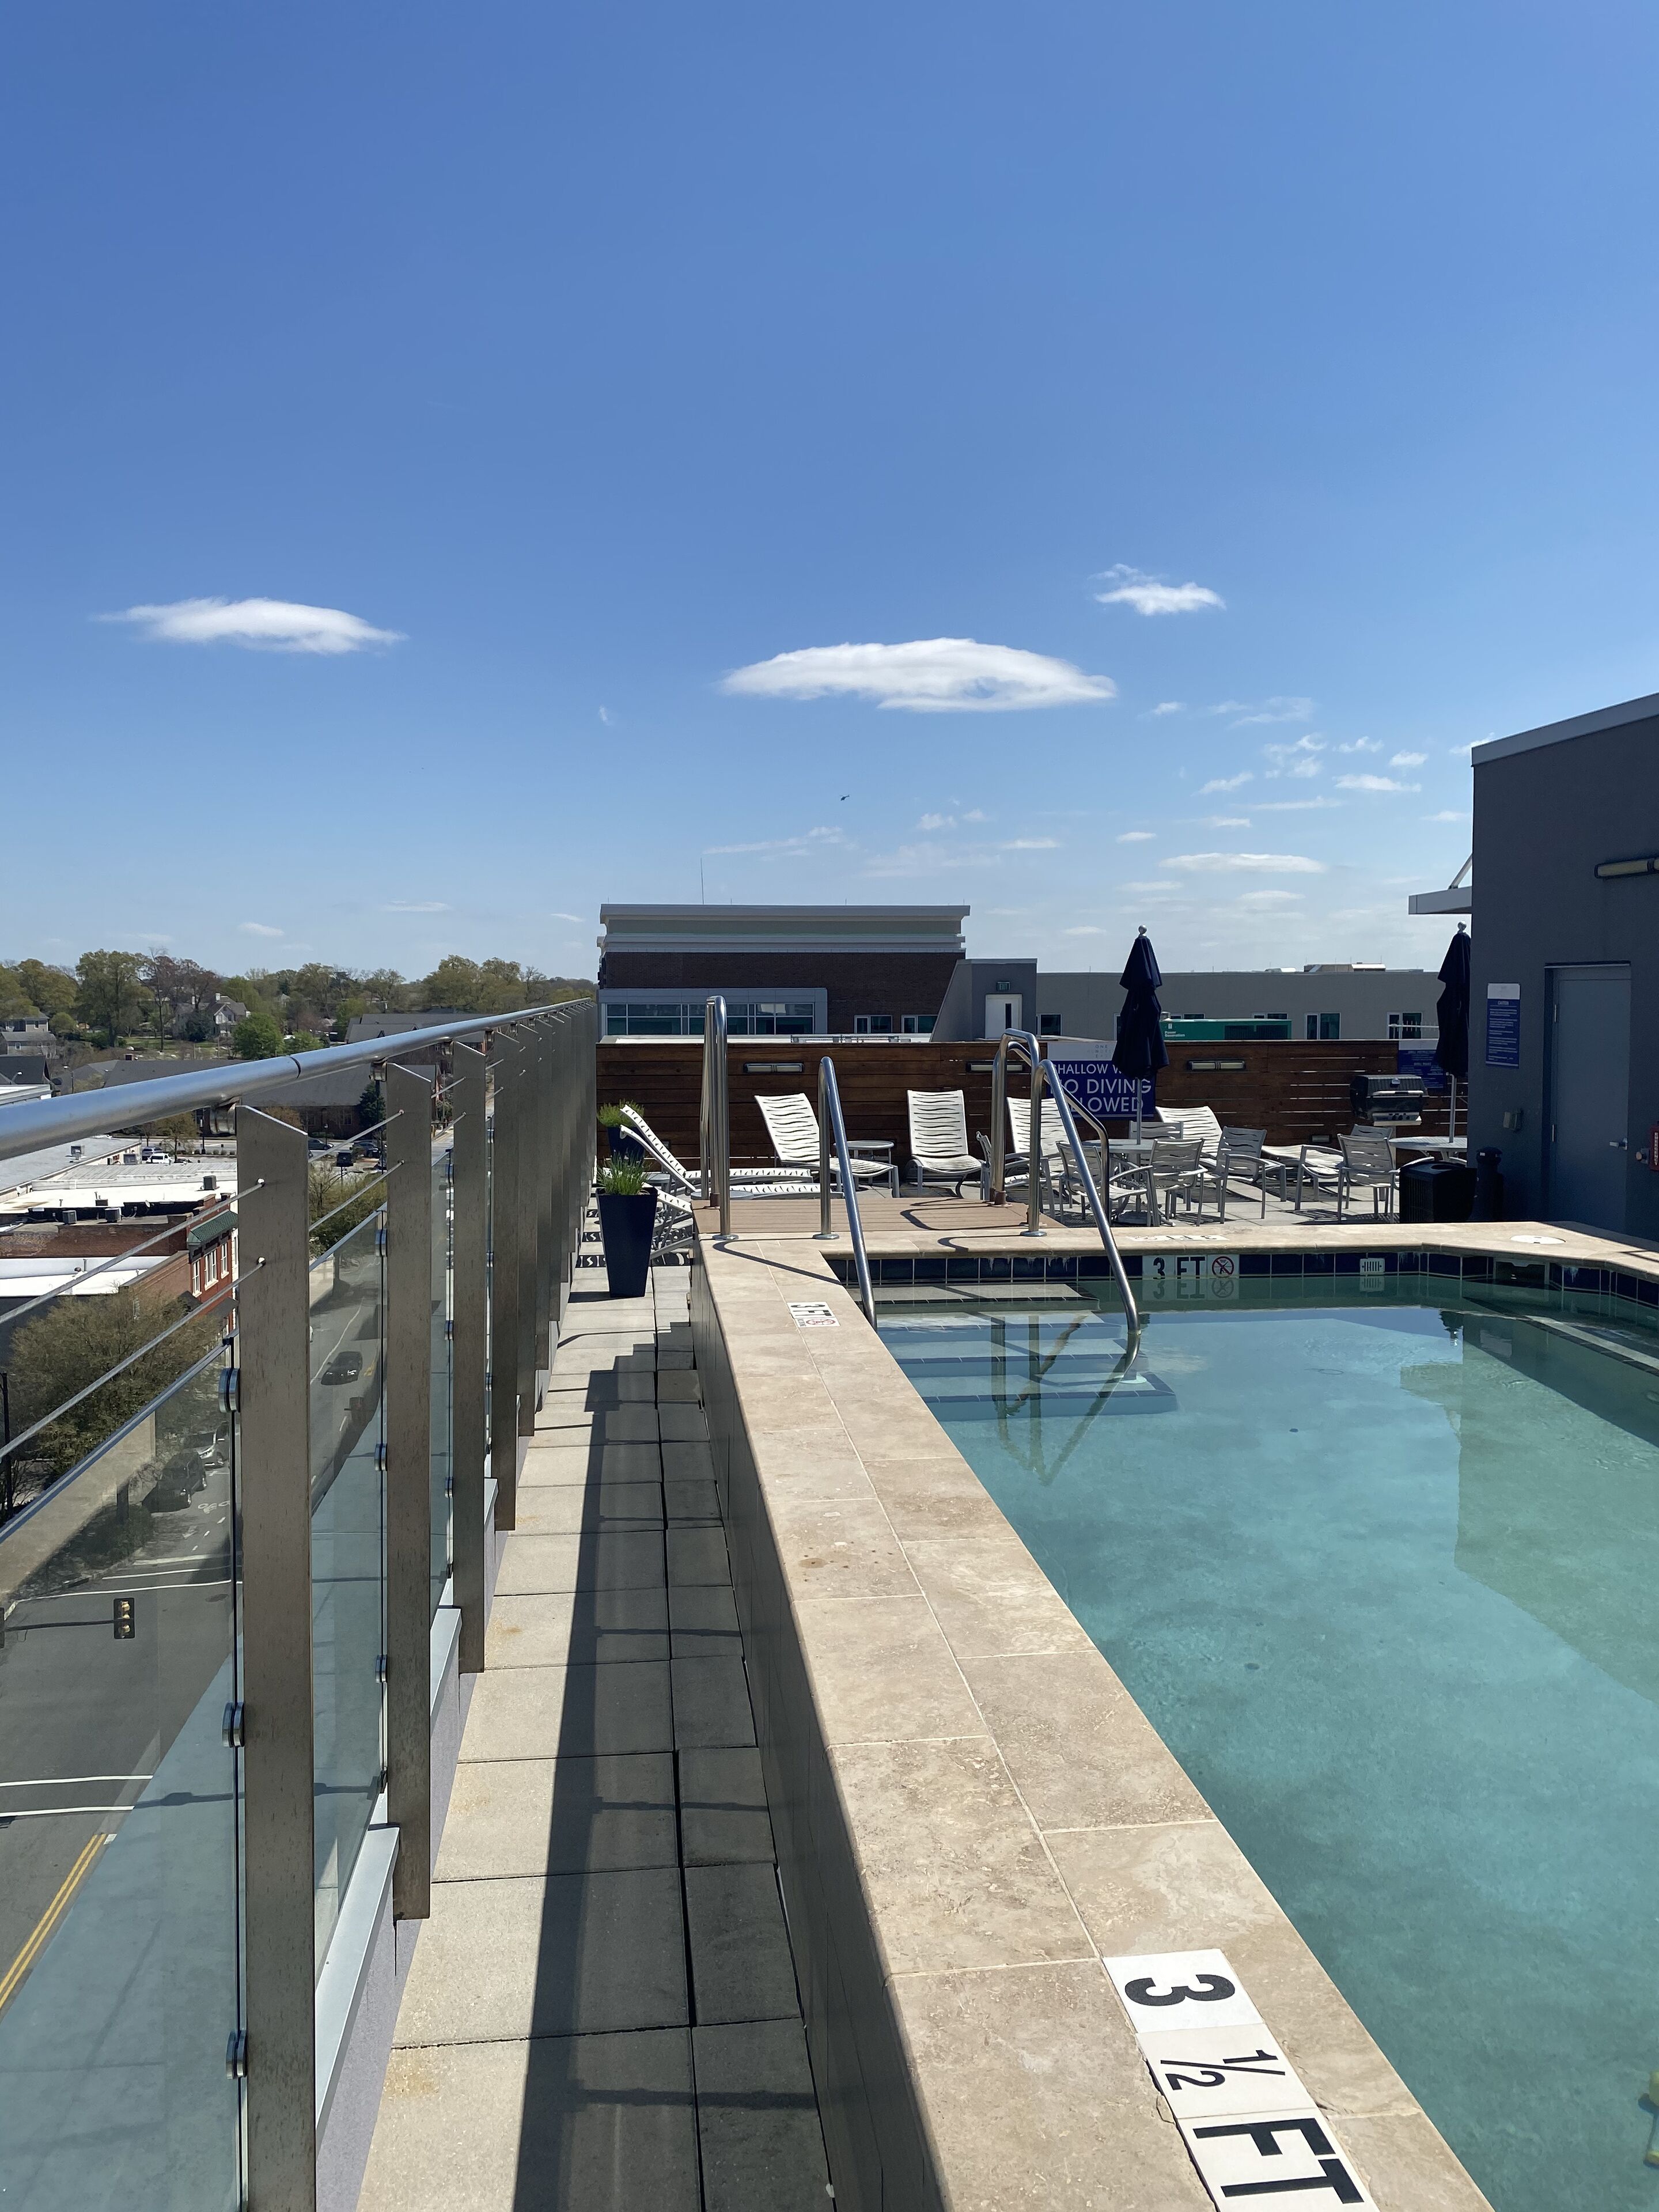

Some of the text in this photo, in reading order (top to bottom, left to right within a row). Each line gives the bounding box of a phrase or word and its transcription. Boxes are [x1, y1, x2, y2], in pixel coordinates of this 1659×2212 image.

[1054, 1064, 1108, 1074] HALLOW
[1051, 1078, 1152, 1094] O DIVING
[1153, 1256, 1205, 1279] 3 FT
[1124, 1974, 1365, 2204] 3 1/2 FT
